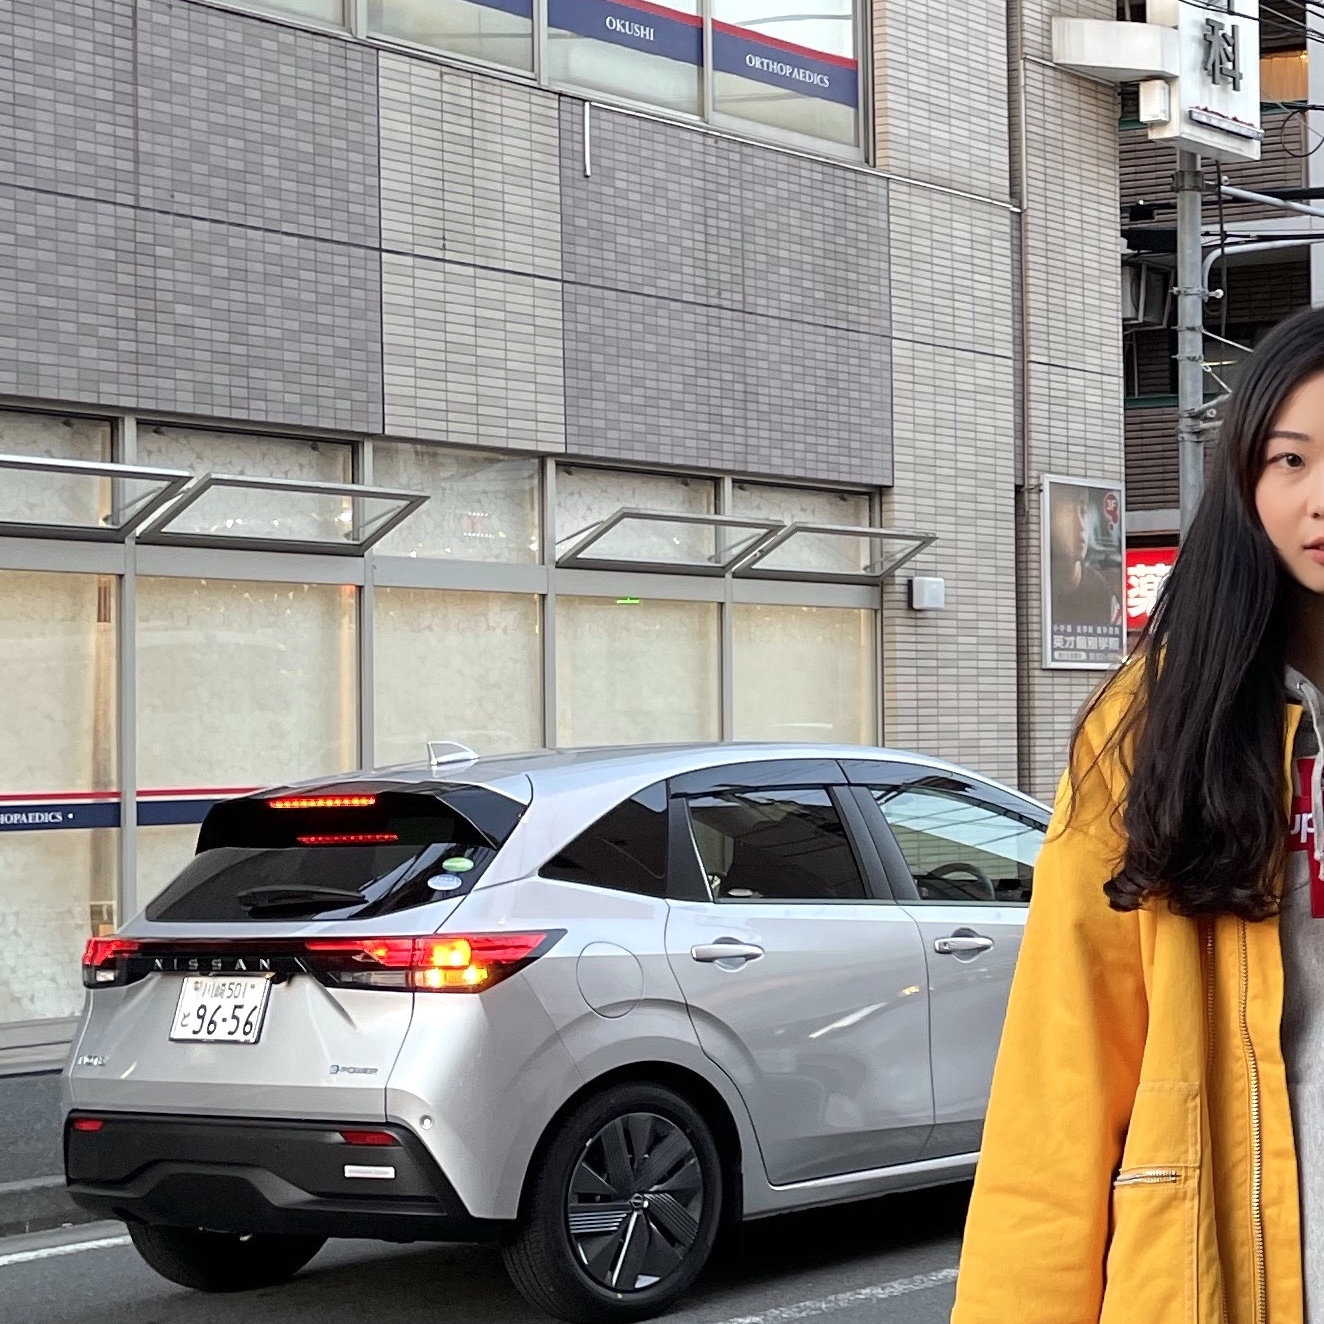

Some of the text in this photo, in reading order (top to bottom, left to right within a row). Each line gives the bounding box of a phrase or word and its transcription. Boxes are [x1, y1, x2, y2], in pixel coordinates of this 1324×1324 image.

[605, 16, 830, 88] OKUSHI ORTHOPAEDICS
[1203, 17, 1243, 92] 科
[154, 958, 271, 970] NISSAN
[192, 1004, 258, 1036] 96-56
